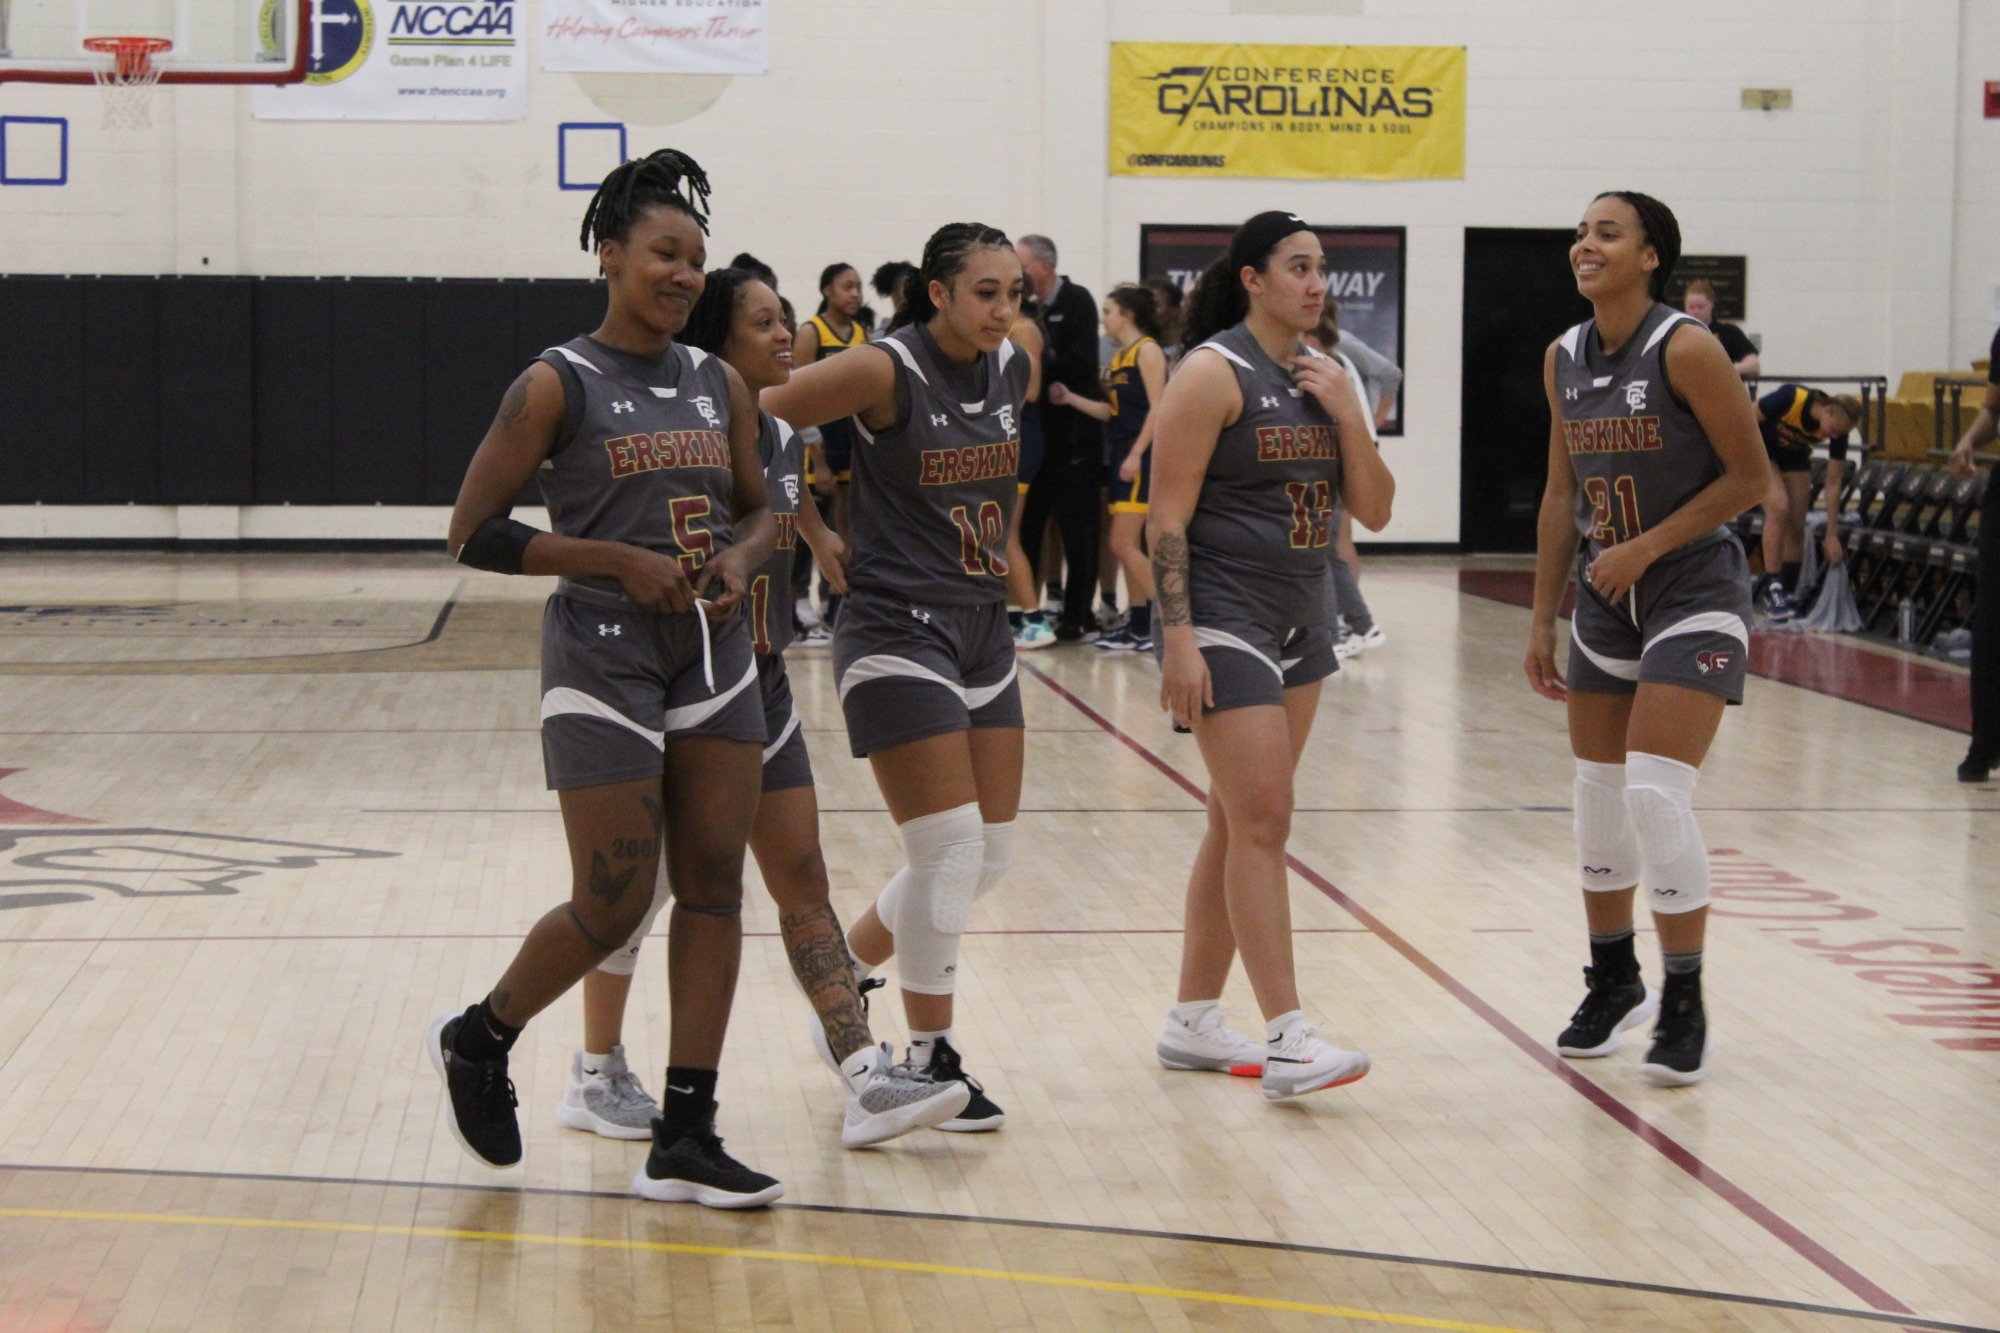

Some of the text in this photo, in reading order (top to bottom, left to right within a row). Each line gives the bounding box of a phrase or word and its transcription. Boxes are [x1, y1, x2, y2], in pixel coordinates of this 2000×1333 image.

[390, 5, 513, 35] NCCAA
[389, 54, 511, 67] Game Plan 4 LIFE
[1216, 66, 1395, 84] CONFERENCE
[398, 87, 506, 99] www.thenccaa.org
[1158, 83, 1434, 119] CAROLINAS
[1193, 121, 1265, 132] CHAMPIONS
[1271, 122, 1284, 132] IN
[1289, 122, 1324, 134] BODY,
[1330, 123, 1362, 133] MIND
[1383, 124, 1412, 134] SOUL
[919, 440, 1021, 486] ERSKIN
[1584, 475, 1641, 546] 21
[668, 495, 714, 588] 5
[950, 501, 1009, 577] 10
